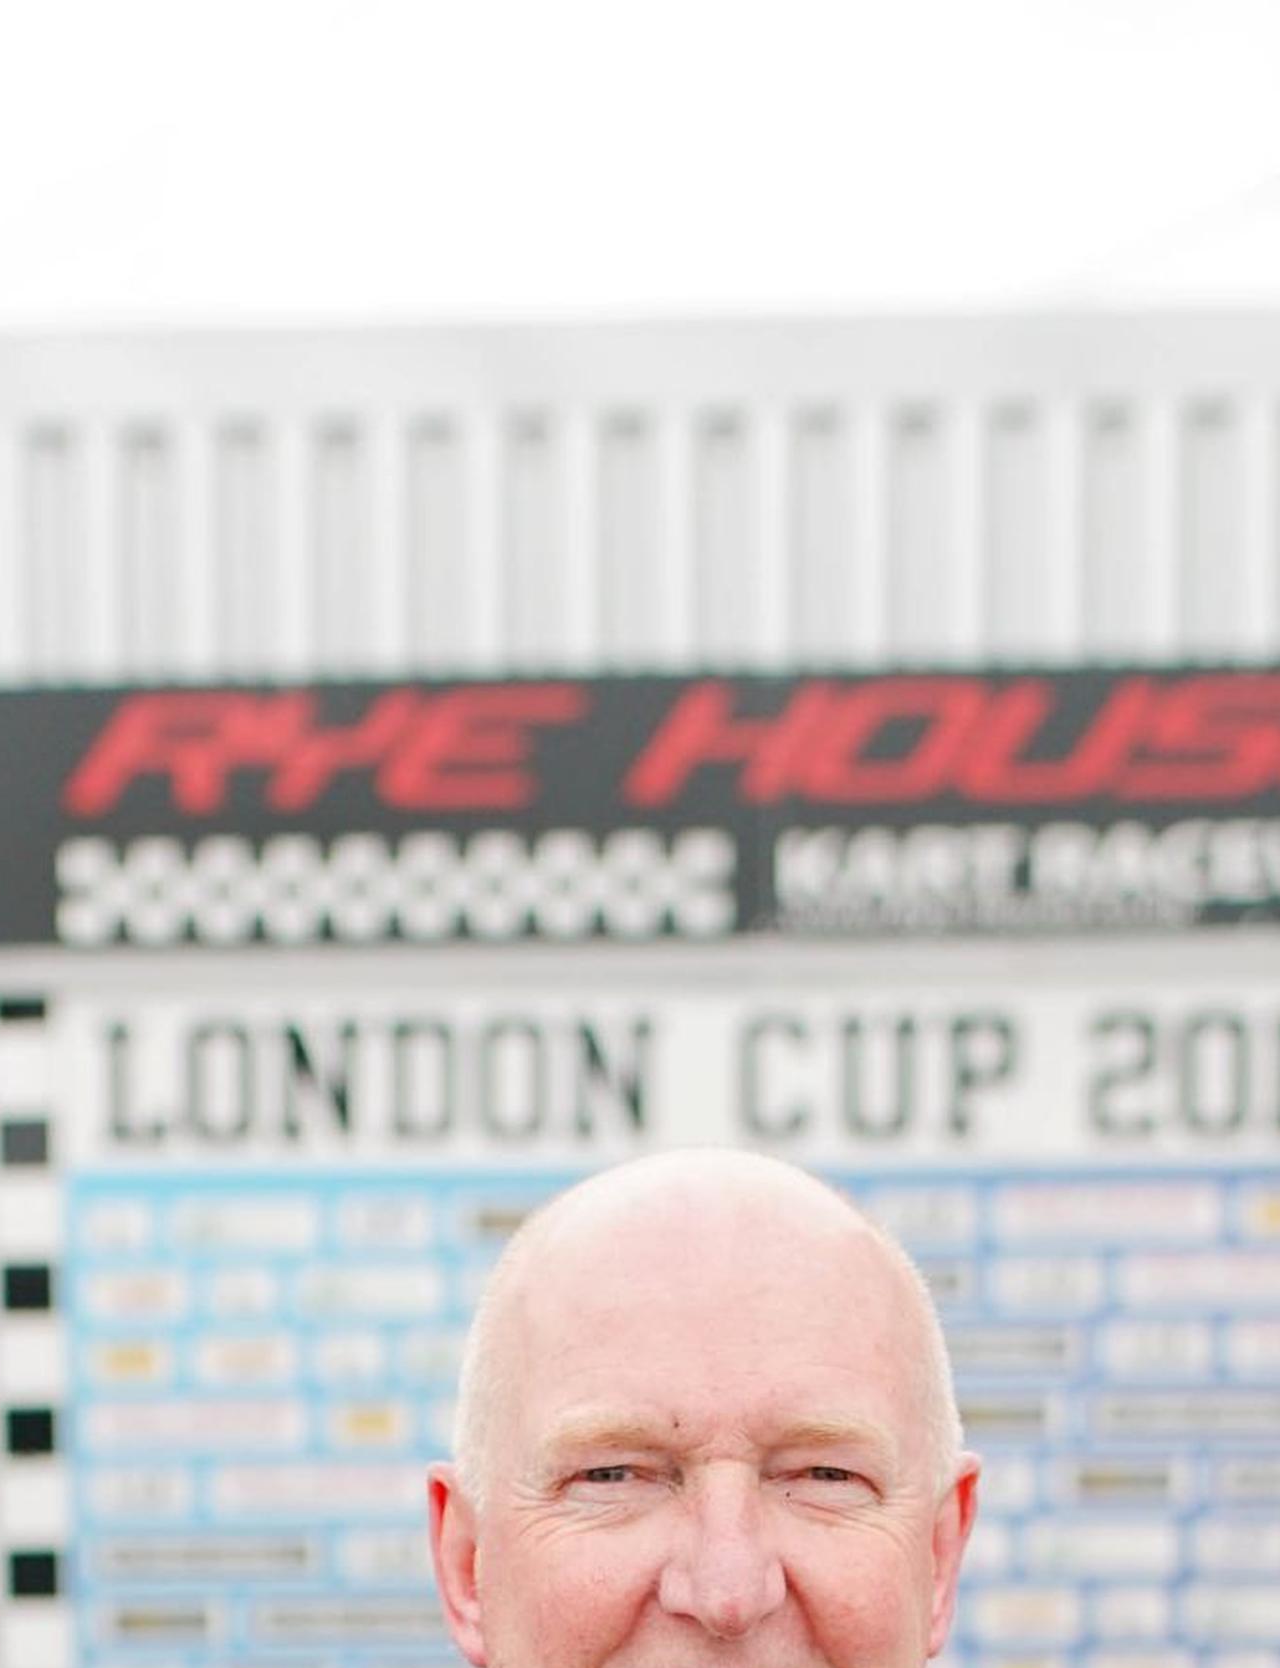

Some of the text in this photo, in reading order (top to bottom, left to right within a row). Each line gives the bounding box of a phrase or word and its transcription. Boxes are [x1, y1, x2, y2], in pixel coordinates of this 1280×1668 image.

[63, 680, 586, 816] RYE
[774, 822, 1026, 906] KART
[107, 1012, 657, 1141] LONDON
[737, 1010, 1022, 1140] CUP
